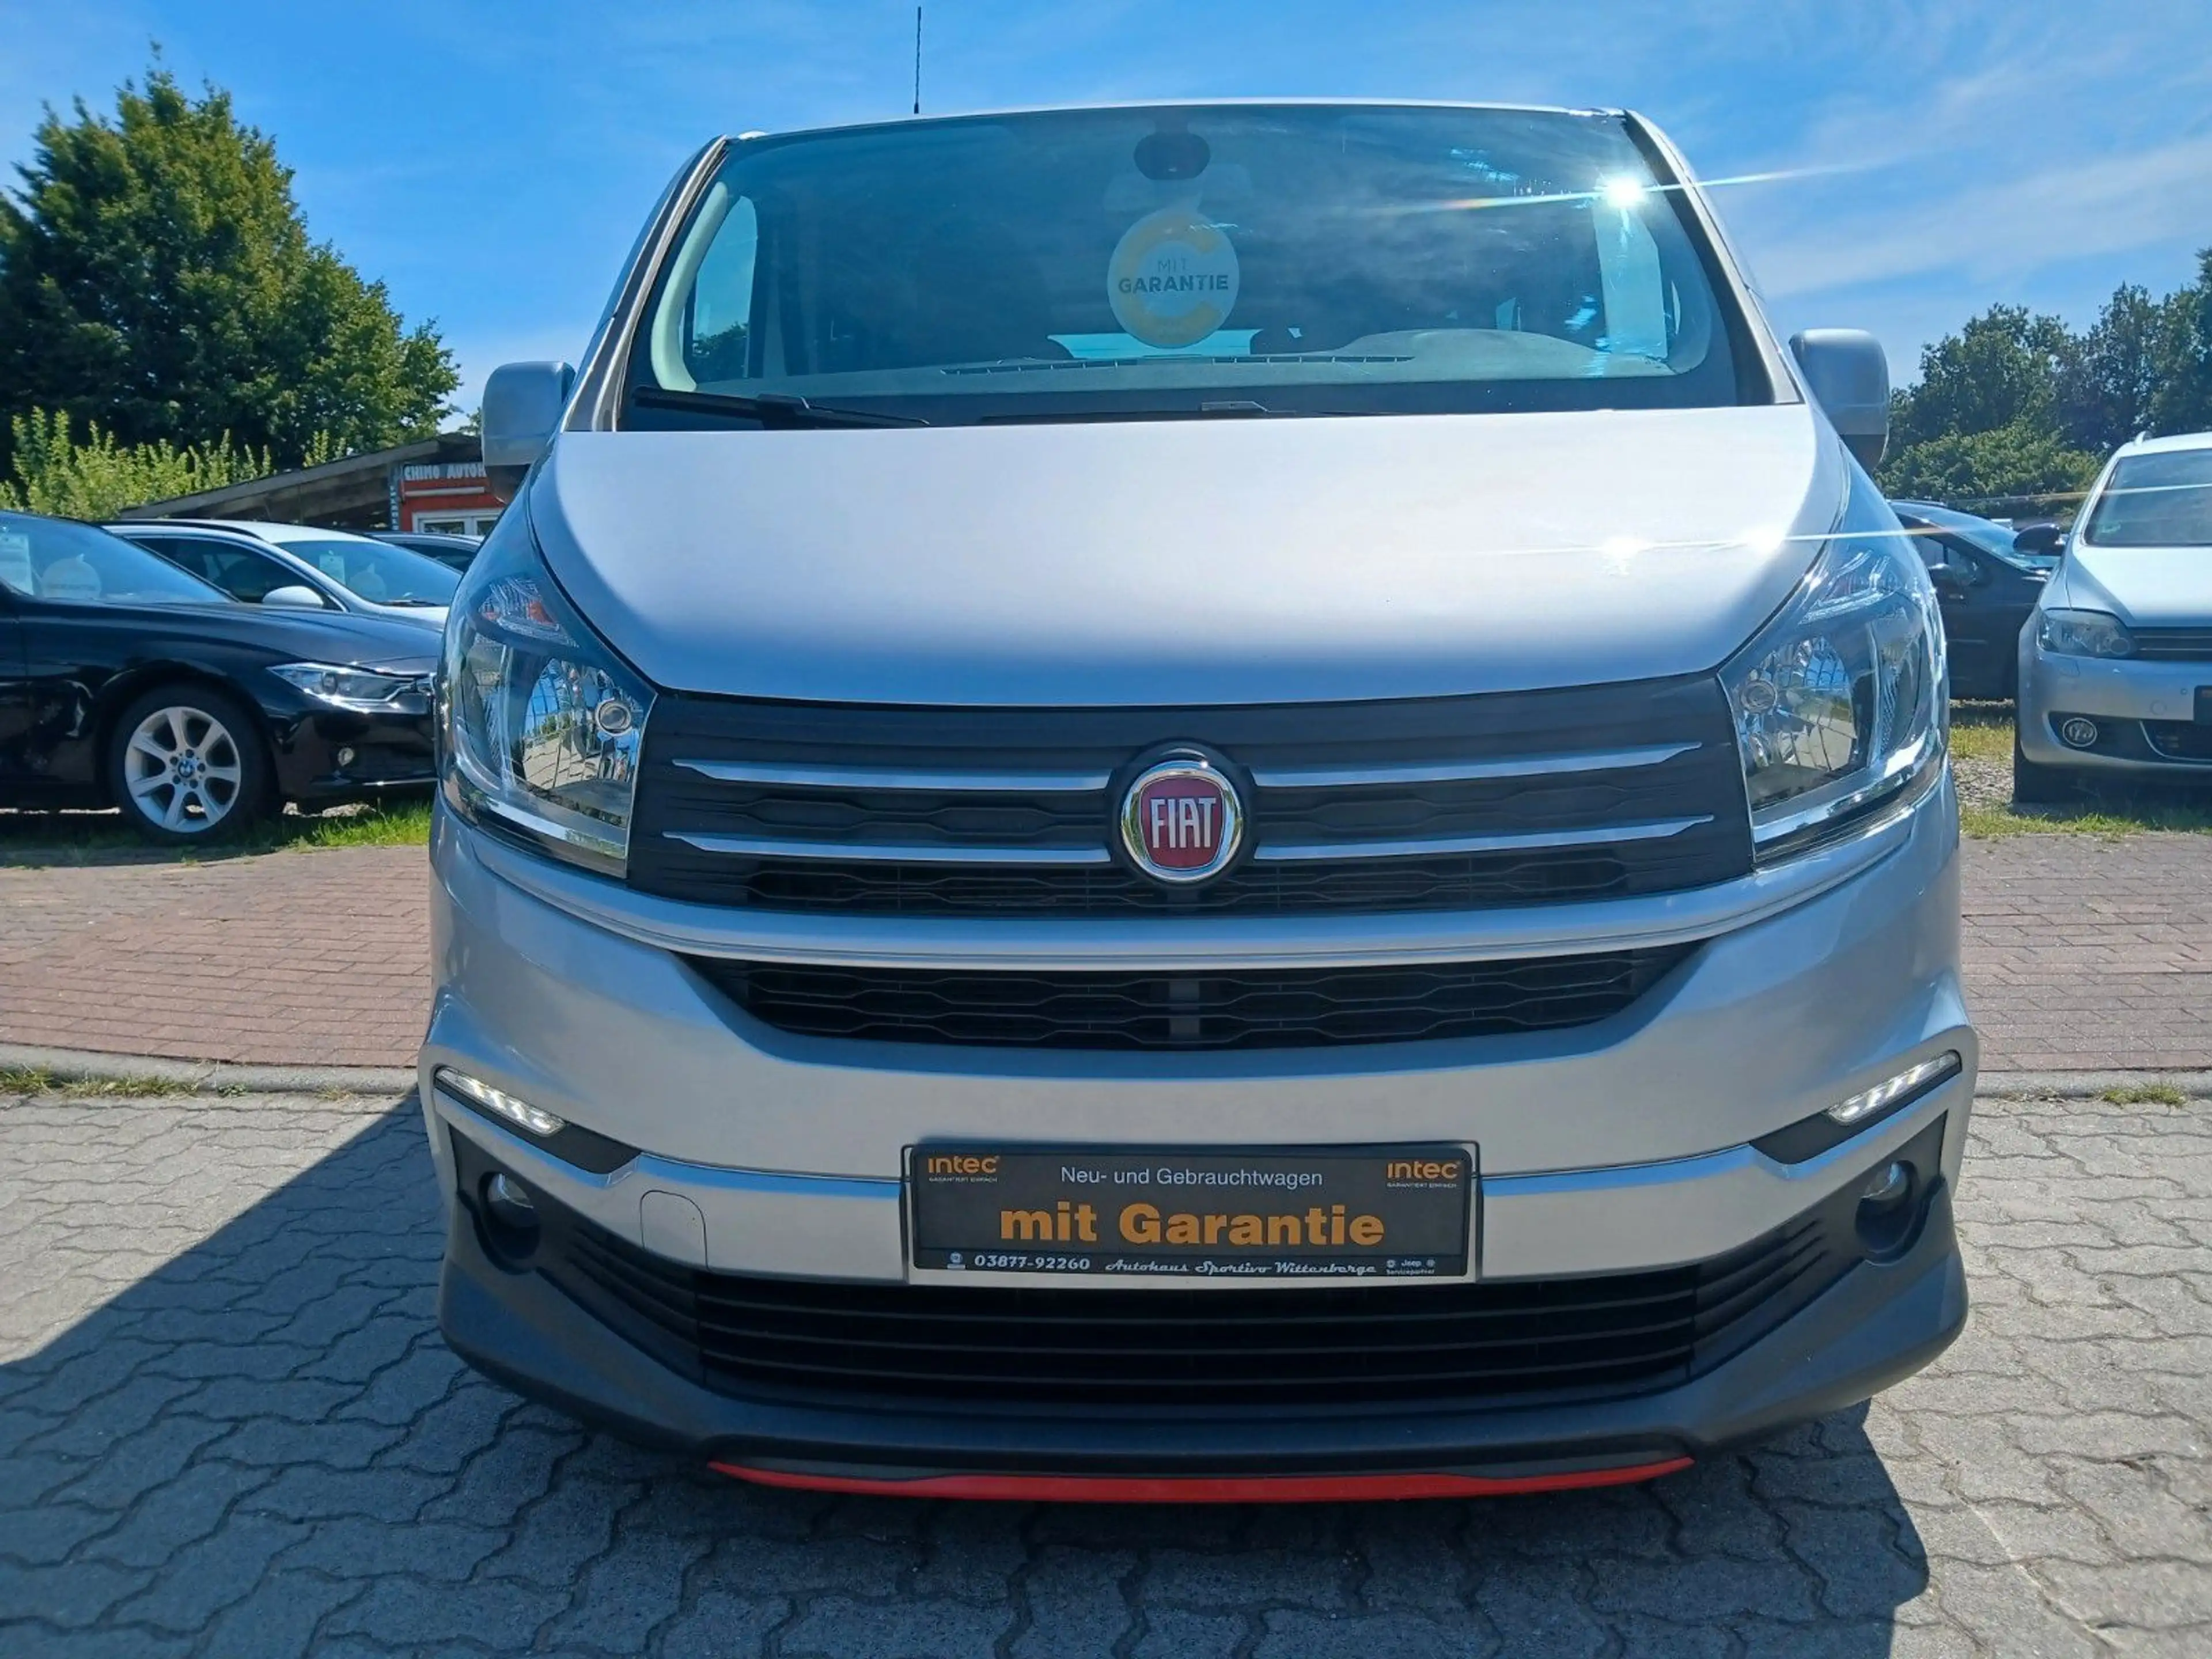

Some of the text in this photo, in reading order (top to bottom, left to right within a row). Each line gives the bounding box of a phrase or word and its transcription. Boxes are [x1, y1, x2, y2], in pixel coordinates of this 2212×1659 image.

[1158, 258, 1186, 273] MIT
[1118, 274, 1229, 294] GARANTIE
[1150, 797, 1217, 849] FIAT
[927, 1156, 997, 1174] intec
[1387, 1161, 1458, 1179] intec
[1060, 1167, 1323, 1191] Neu- und Gebrauchtwagen
[1000, 1201, 1385, 1246] mit Garantie
[975, 1255, 1090, 1270] 03877-92260
[1105, 1259, 1189, 1272] Autohaus
[1195, 1260, 1272, 1275] Sportivo
